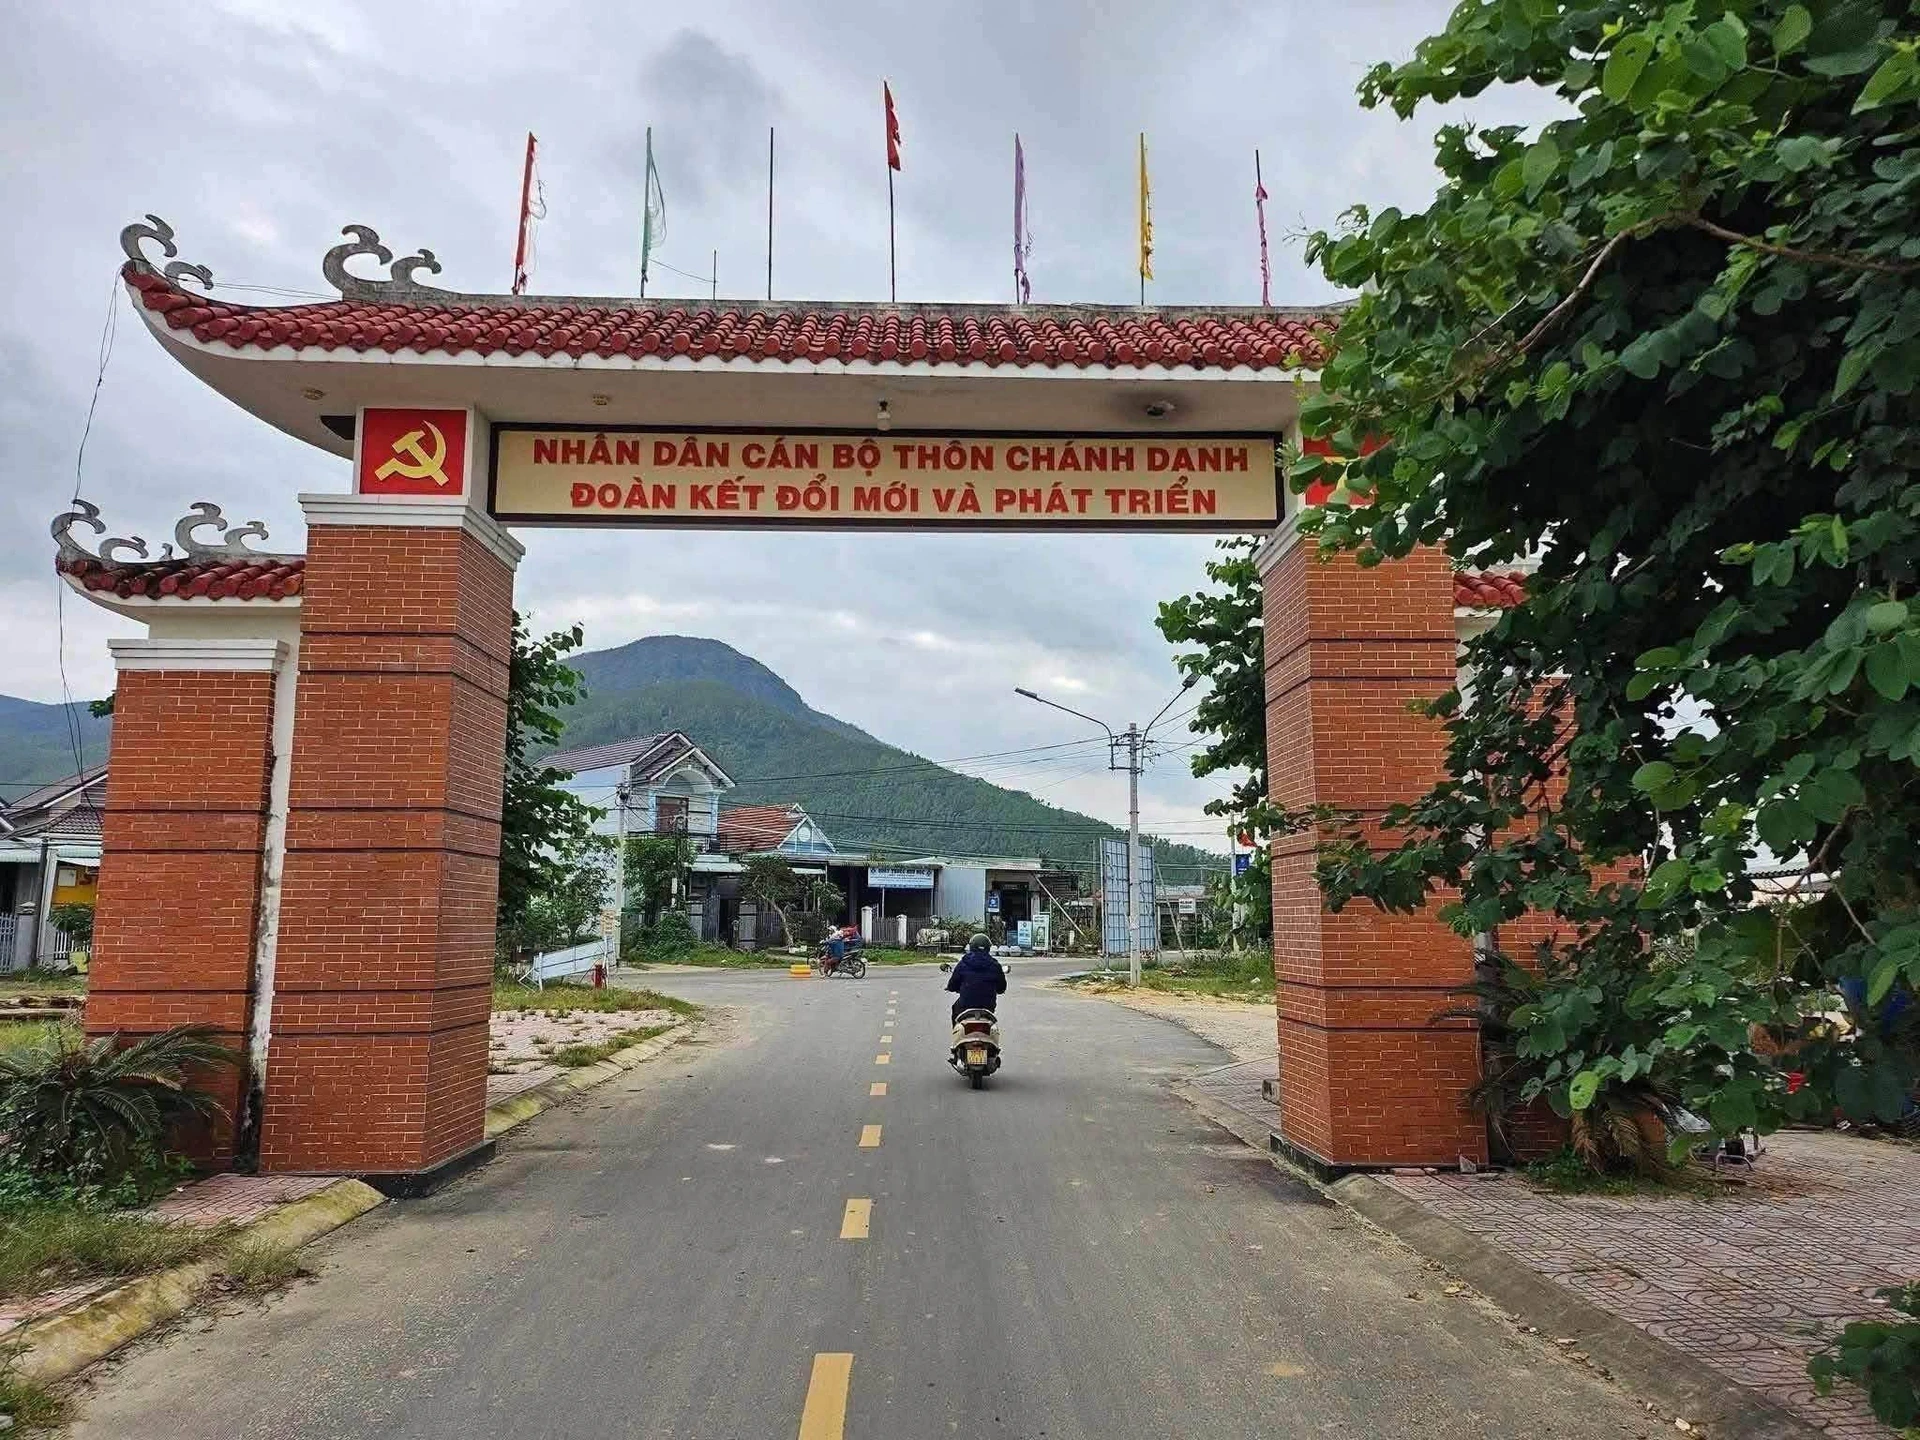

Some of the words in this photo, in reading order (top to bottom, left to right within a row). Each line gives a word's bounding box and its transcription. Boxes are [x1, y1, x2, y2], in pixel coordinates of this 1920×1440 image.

[533, 434, 640, 465] NHÂN
[653, 436, 730, 468] DÂN
[741, 436, 819, 469] CÁN
[832, 438, 881, 477] BỘ
[893, 440, 994, 471] THÔN
[1005, 441, 1135, 472] CHÁNH
[1147, 446, 1249, 472] DANH
[570, 477, 676, 509] ĐOÀN
[690, 475, 765, 510] KẾT
[776, 473, 839, 511] ĐỔI
[853, 480, 919, 512] MỚI
[932, 481, 982, 513] VÀ
[995, 481, 1093, 514] PHÁT
[1104, 475, 1216, 515] TRIỂN
